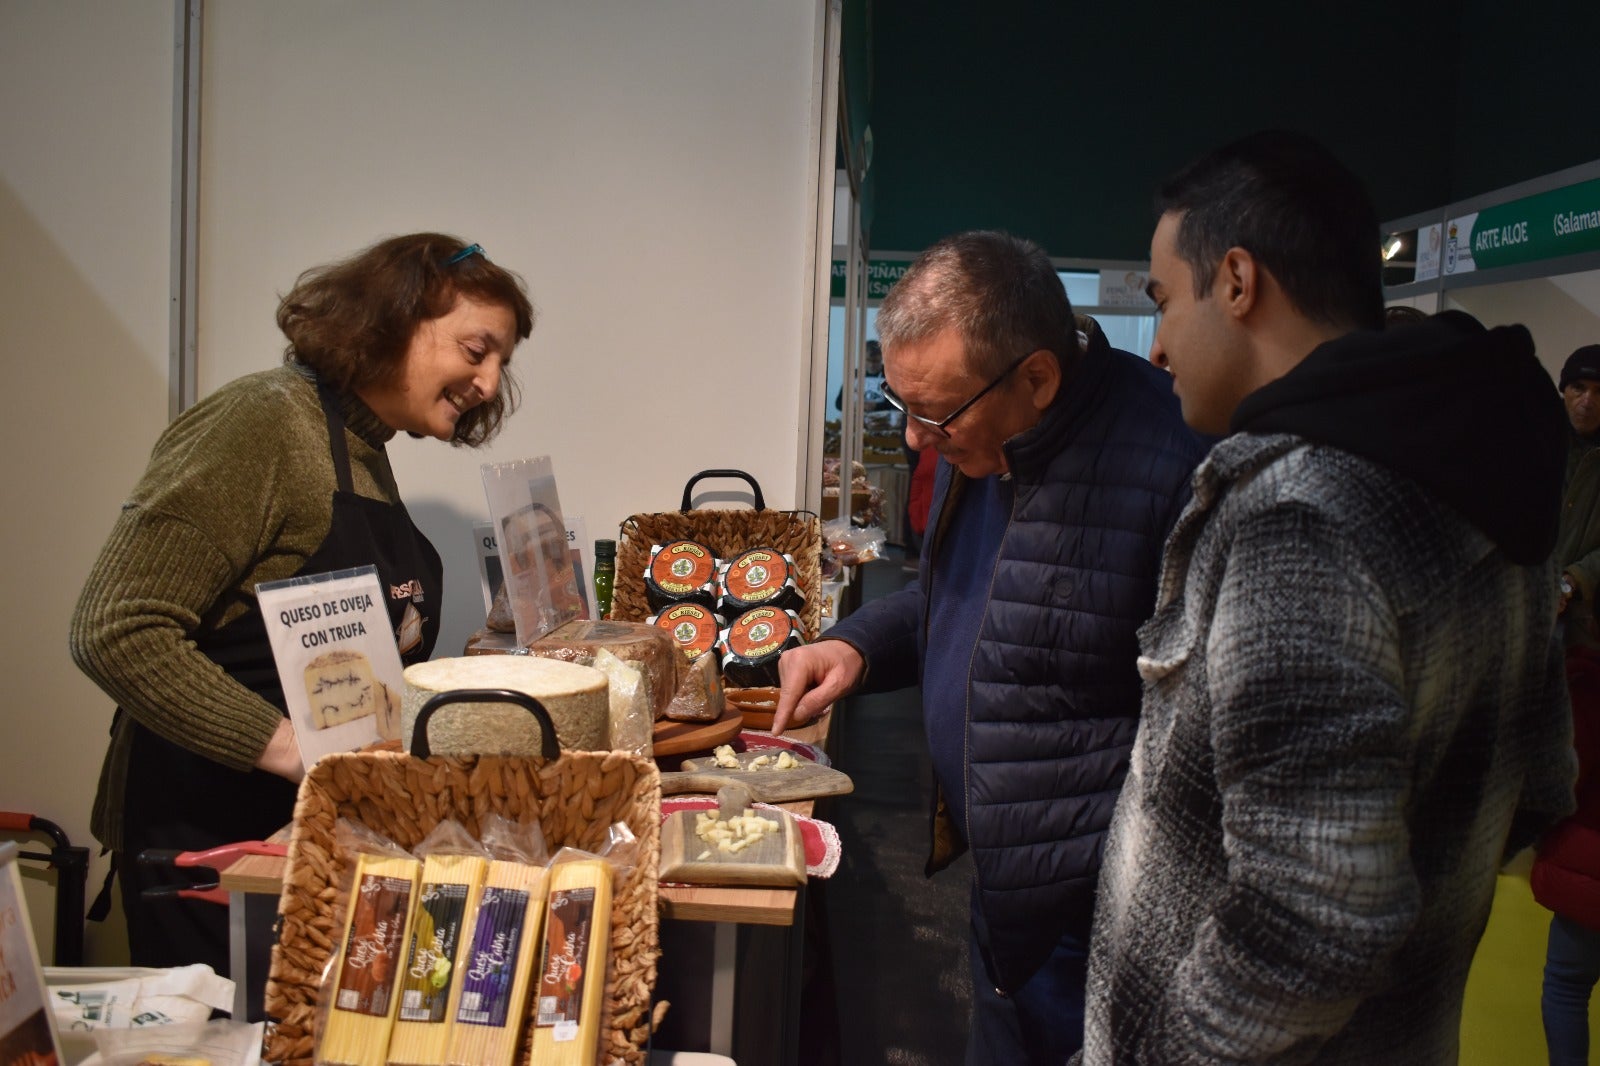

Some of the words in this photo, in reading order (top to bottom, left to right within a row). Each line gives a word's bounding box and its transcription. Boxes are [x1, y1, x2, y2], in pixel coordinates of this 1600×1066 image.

[1475, 228, 1500, 251] ARTE
[1501, 221, 1529, 247] ALOE
[280, 604, 322, 628] QUESO
[323, 601, 339, 617] DE
[340, 594, 374, 613] OVEJA
[301, 629, 329, 649] CON
[329, 621, 367, 643] TRUFA
[368, 921, 388, 953] Cabra
[427, 928, 445, 961] Cabra
[486, 932, 506, 965] Cabra
[560, 931, 576, 965] Cabra
[349, 939, 368, 969] Queso
[410, 948, 428, 978] Queso
[468, 951, 487, 980] Queso
[545, 954, 561, 984] Queso
